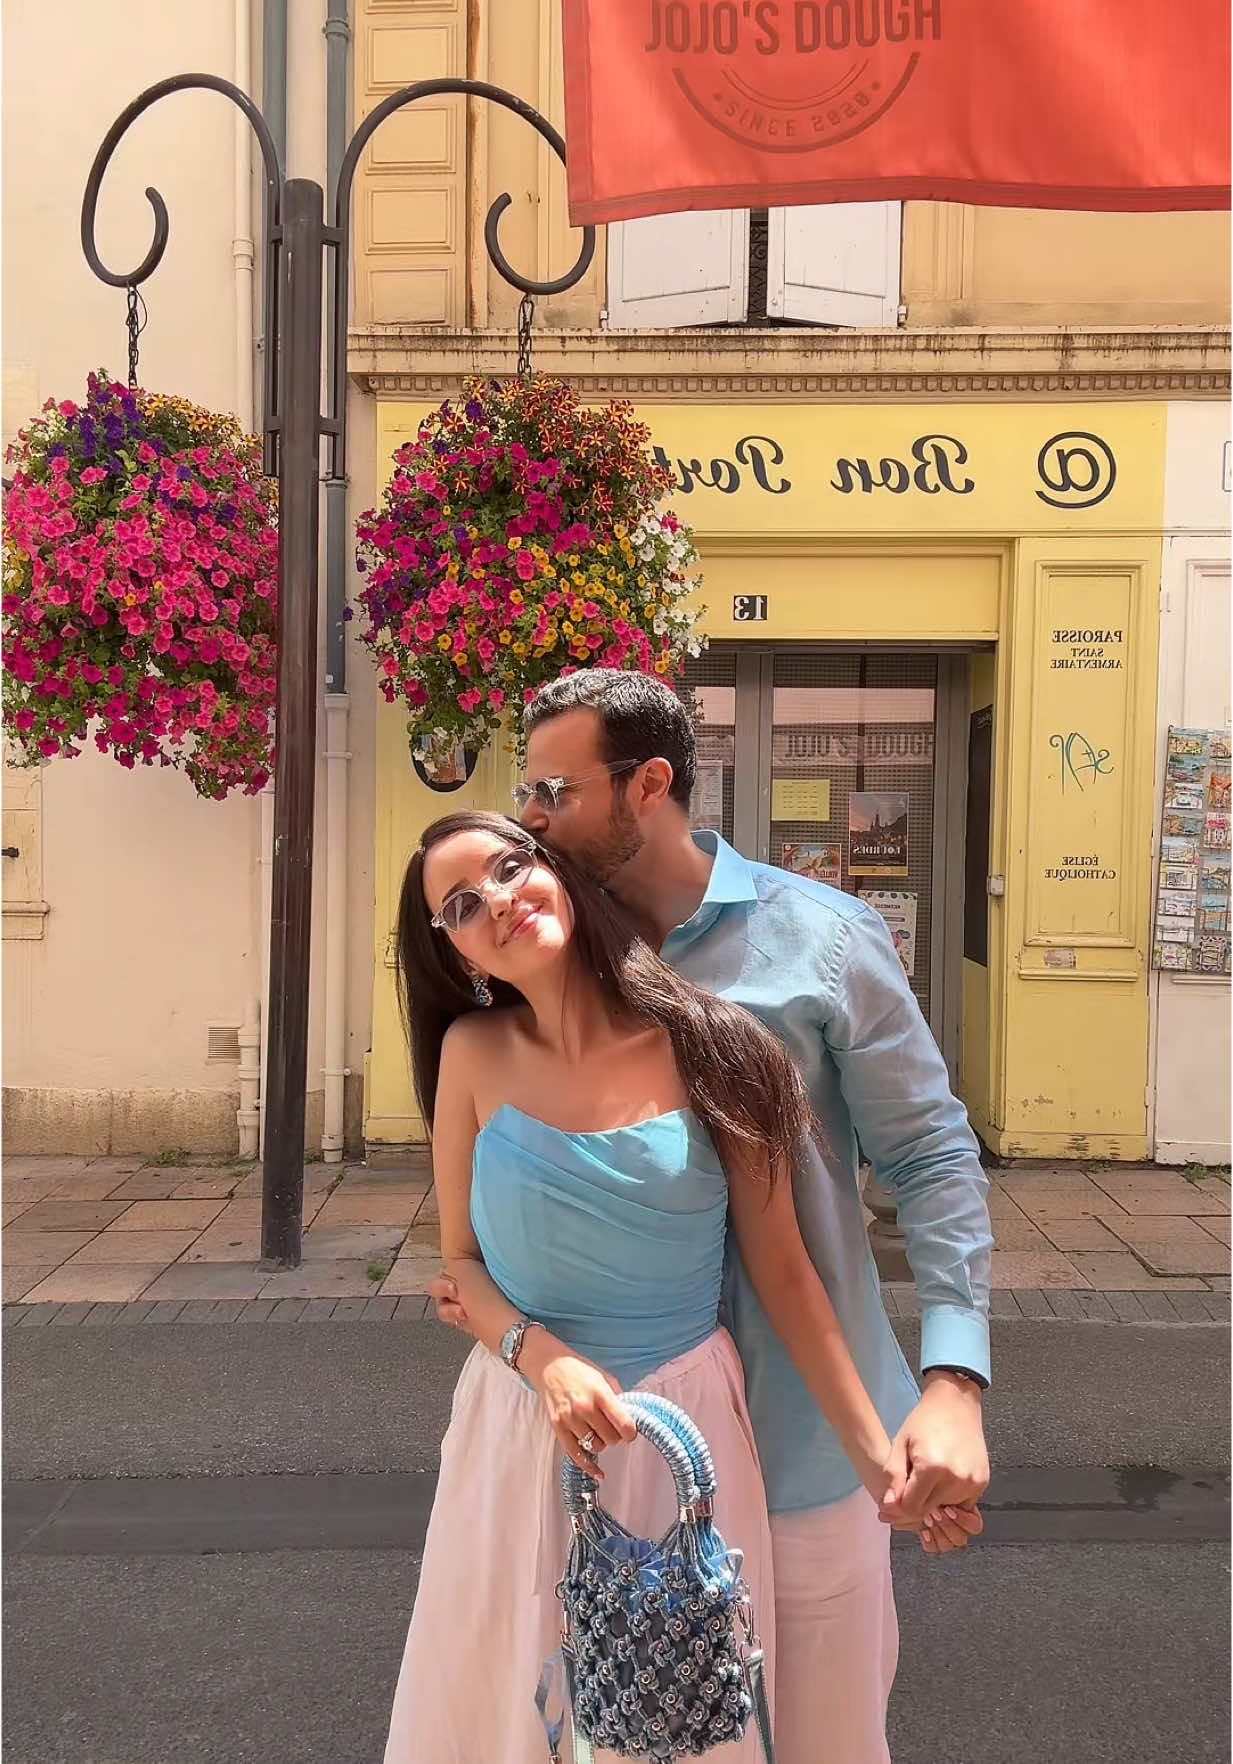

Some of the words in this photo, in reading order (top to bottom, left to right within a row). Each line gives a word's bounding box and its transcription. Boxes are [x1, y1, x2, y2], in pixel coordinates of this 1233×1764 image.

[645, 0, 780, 55] JOJO'S
[794, 0, 942, 53] DOUGH
[724, 101, 796, 137] SINCE
[810, 90, 872, 132] 2020
